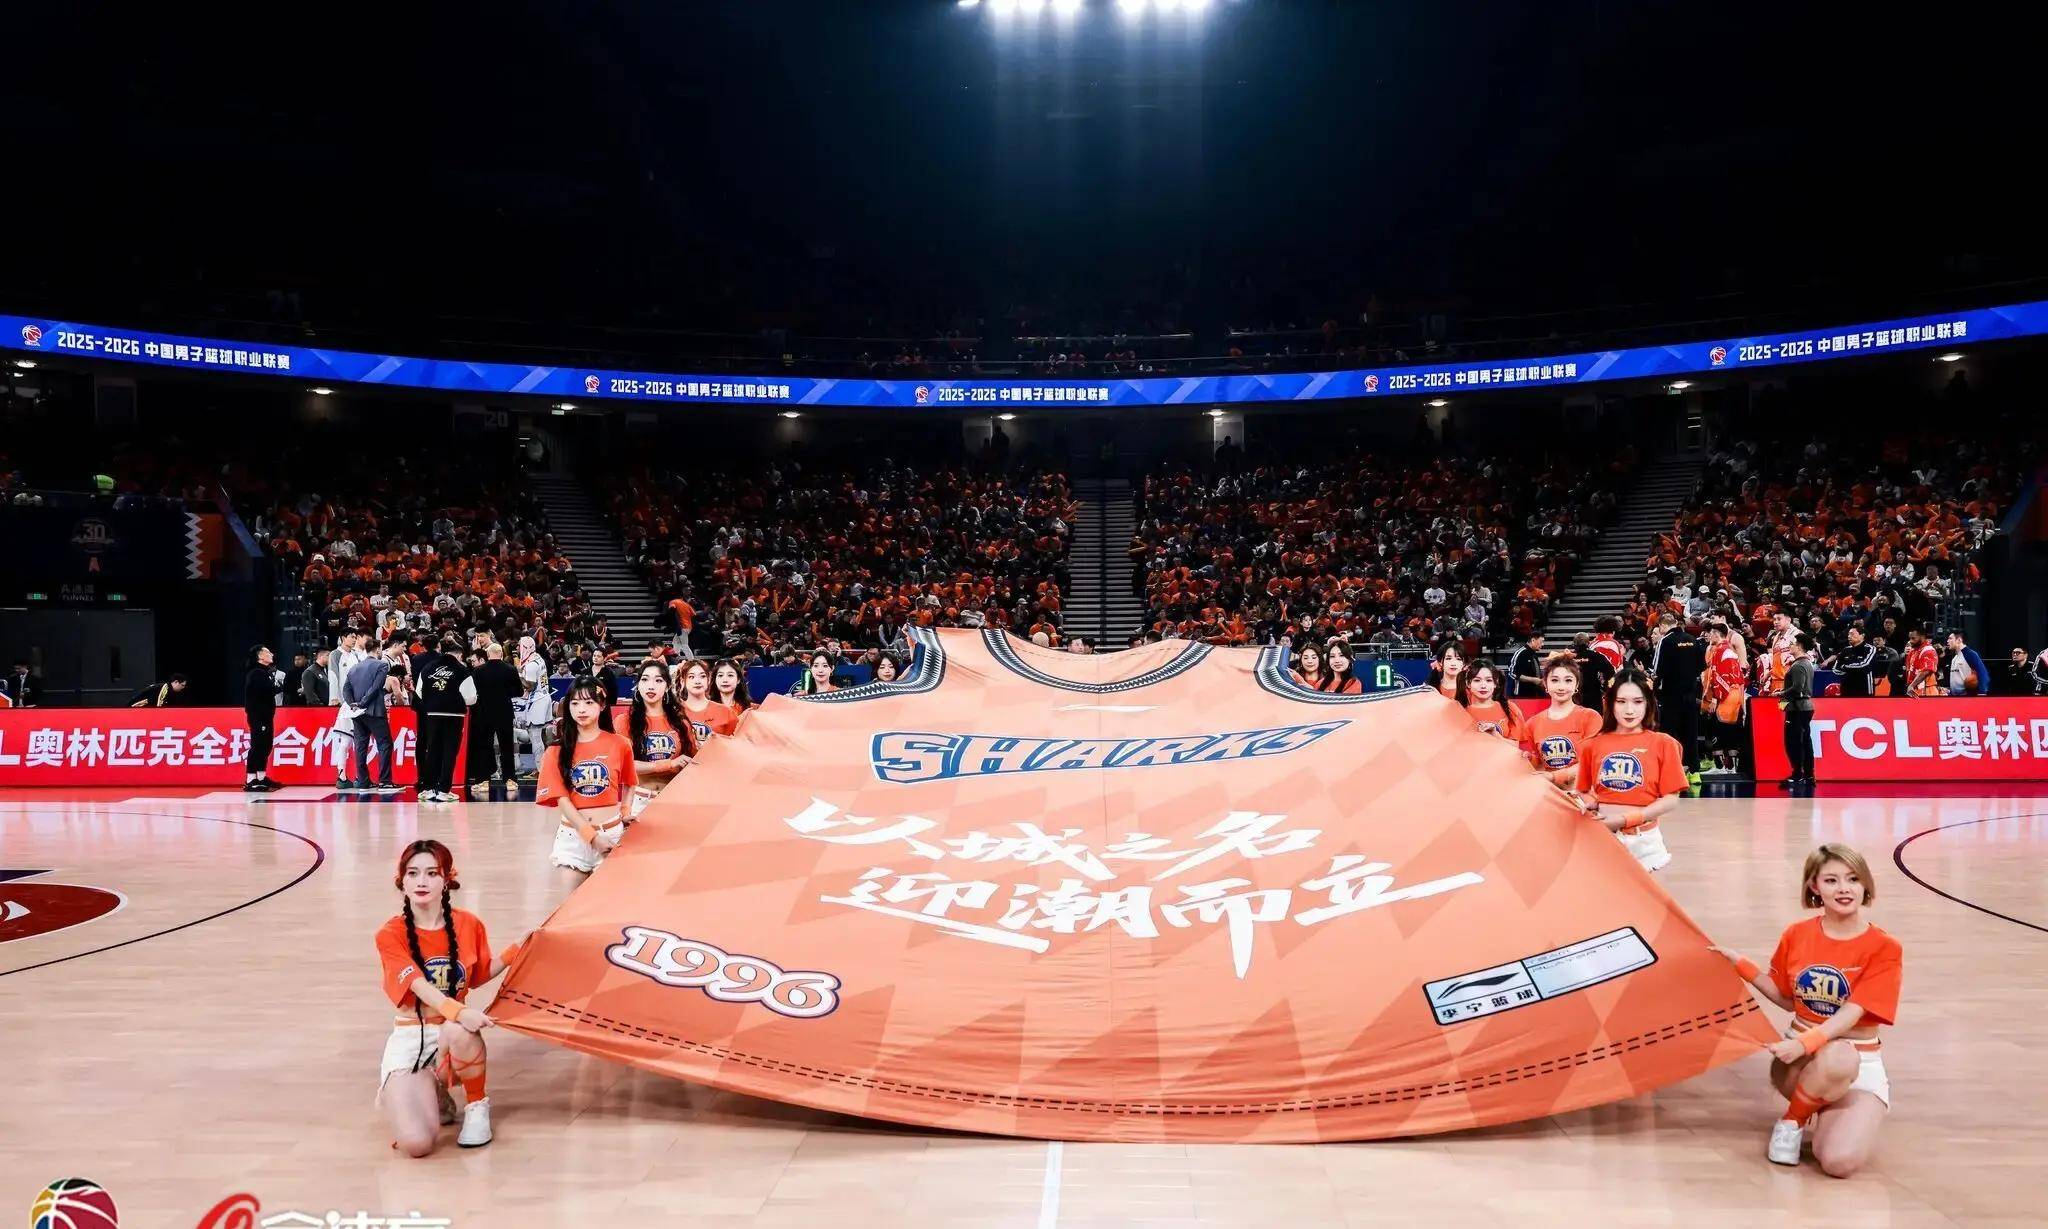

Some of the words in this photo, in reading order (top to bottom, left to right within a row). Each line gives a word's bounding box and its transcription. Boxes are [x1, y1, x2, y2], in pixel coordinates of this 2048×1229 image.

[57, 332, 140, 356] 2025-2026
[145, 341, 290, 370] 中国男子篮球职业联赛
[1740, 341, 1812, 361] 2025-2026
[1818, 321, 1967, 353] 中国男子篮球职业联赛
[611, 379, 672, 396] 2025-2026
[677, 382, 790, 399] 中国男子篮球职业联赛
[1389, 373, 1451, 389] 2025-2026
[1456, 364, 1577, 385] 中国男子篮球职业联赛
[938, 388, 996, 401] 2025-2026
[1000, 387, 1109, 401] 中国男子篮球职业联赛
[648, 736, 669, 750] 30
[1545, 740, 1567, 757] 30
[1810, 717, 1933, 759] TCL
[870, 719, 1357, 785] SHARKS
[578, 765, 602, 783] 30
[1609, 758, 1634, 778] 30
[781, 796, 1322, 881] 以城之名
[820, 854, 1485, 980] 迎潮而立
[604, 925, 842, 1019] 1996
[1808, 971, 1840, 998] 30
